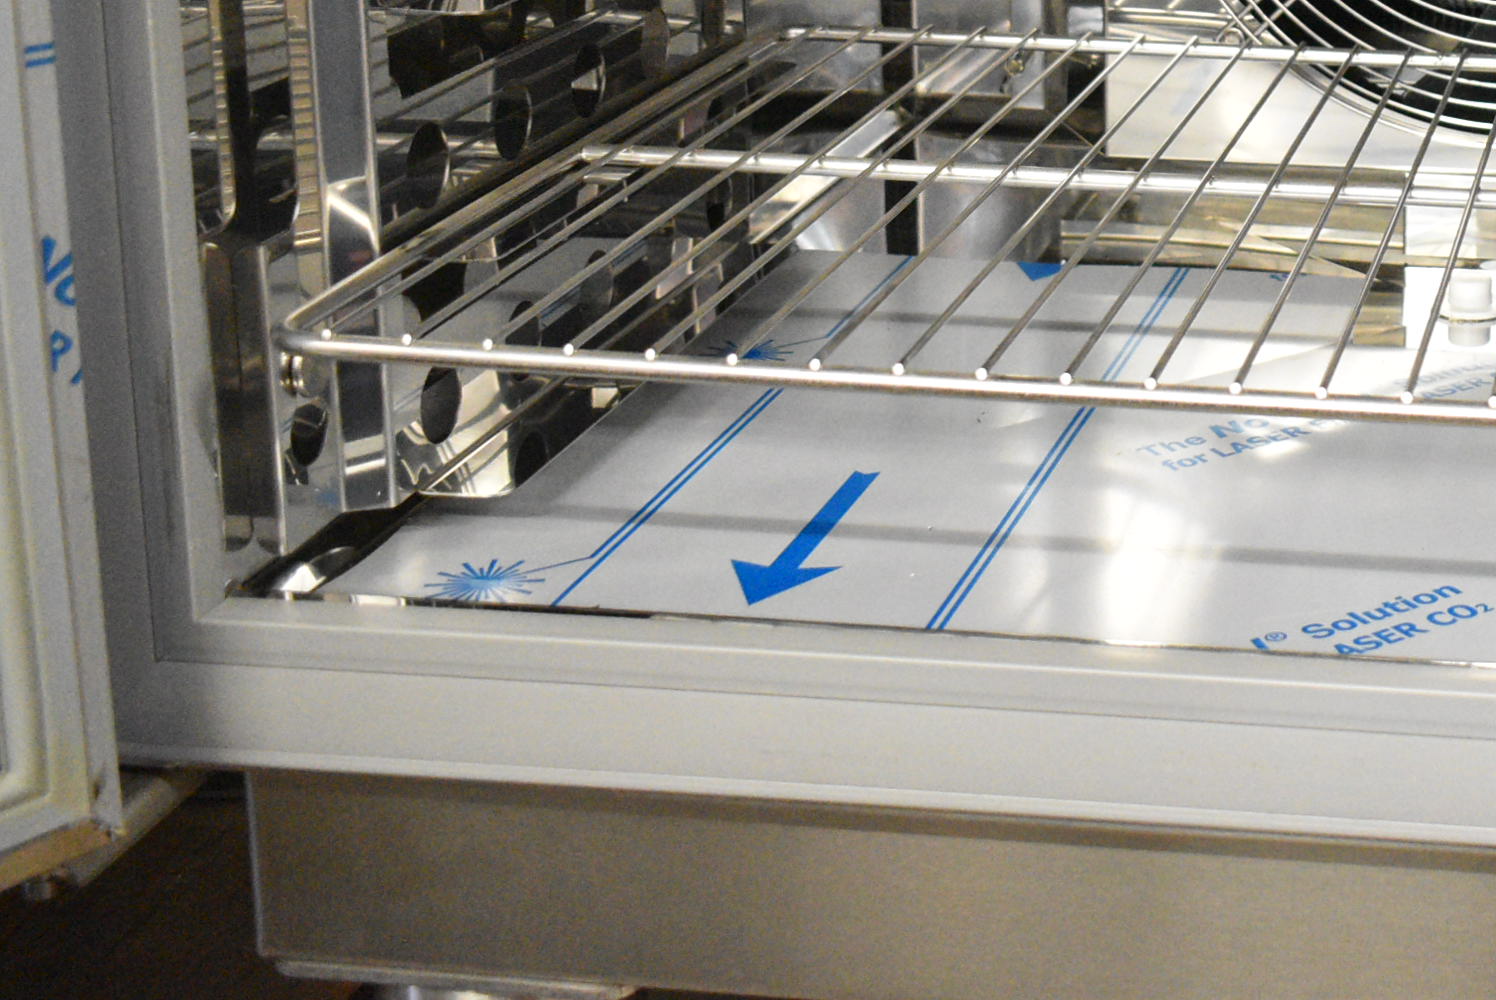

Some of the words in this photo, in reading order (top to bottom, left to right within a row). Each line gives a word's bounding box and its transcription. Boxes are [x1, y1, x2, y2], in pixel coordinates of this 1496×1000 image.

[1420, 376, 1492, 398] ASER
[1136, 433, 1208, 457] The
[1161, 452, 1209, 472] for
[1209, 426, 1312, 459] LASER
[1301, 584, 1463, 640] Solution
[1333, 621, 1430, 656] ASER
